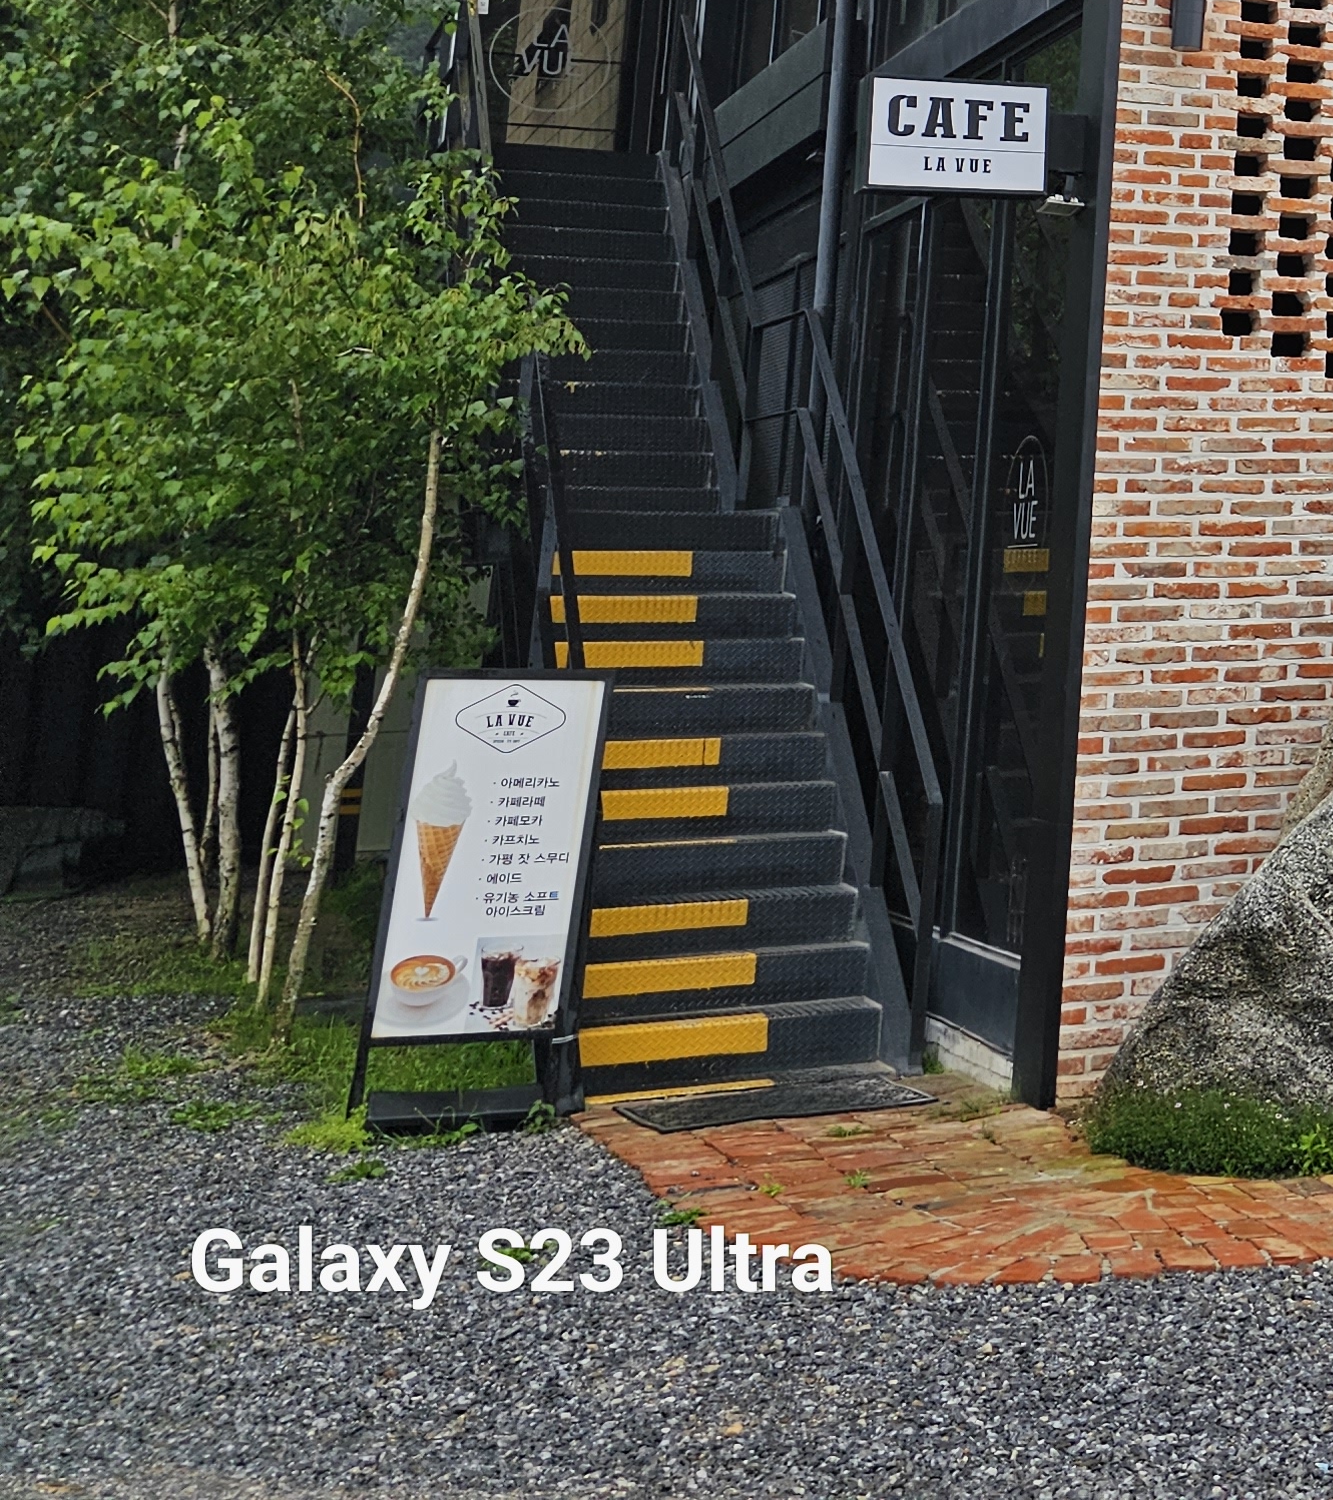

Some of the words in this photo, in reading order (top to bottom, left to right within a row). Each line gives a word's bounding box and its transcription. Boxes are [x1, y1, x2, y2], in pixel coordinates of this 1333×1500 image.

[888, 94, 1030, 142] CAFE
[923, 156, 946, 173] LA
[955, 157, 992, 174] VUE
[1018, 460, 1035, 500] LA
[1013, 500, 1038, 539] VUE
[486, 714, 503, 728] LA
[508, 713, 535, 728] VUE
[500, 777, 560, 789] 아메리카노
[498, 796, 546, 808] 카페라떼
[495, 815, 543, 827] 카페모카
[492, 834, 540, 846] 카프치노
[489, 853, 513, 866] 가평
[518, 852, 530, 865] 잣
[533, 852, 569, 864] 스무디
[486, 872, 522, 885] 에이드
[483, 892, 519, 904] 유기농
[523, 891, 560, 902] 소프트
[485, 904, 546, 918] 아이스크림
